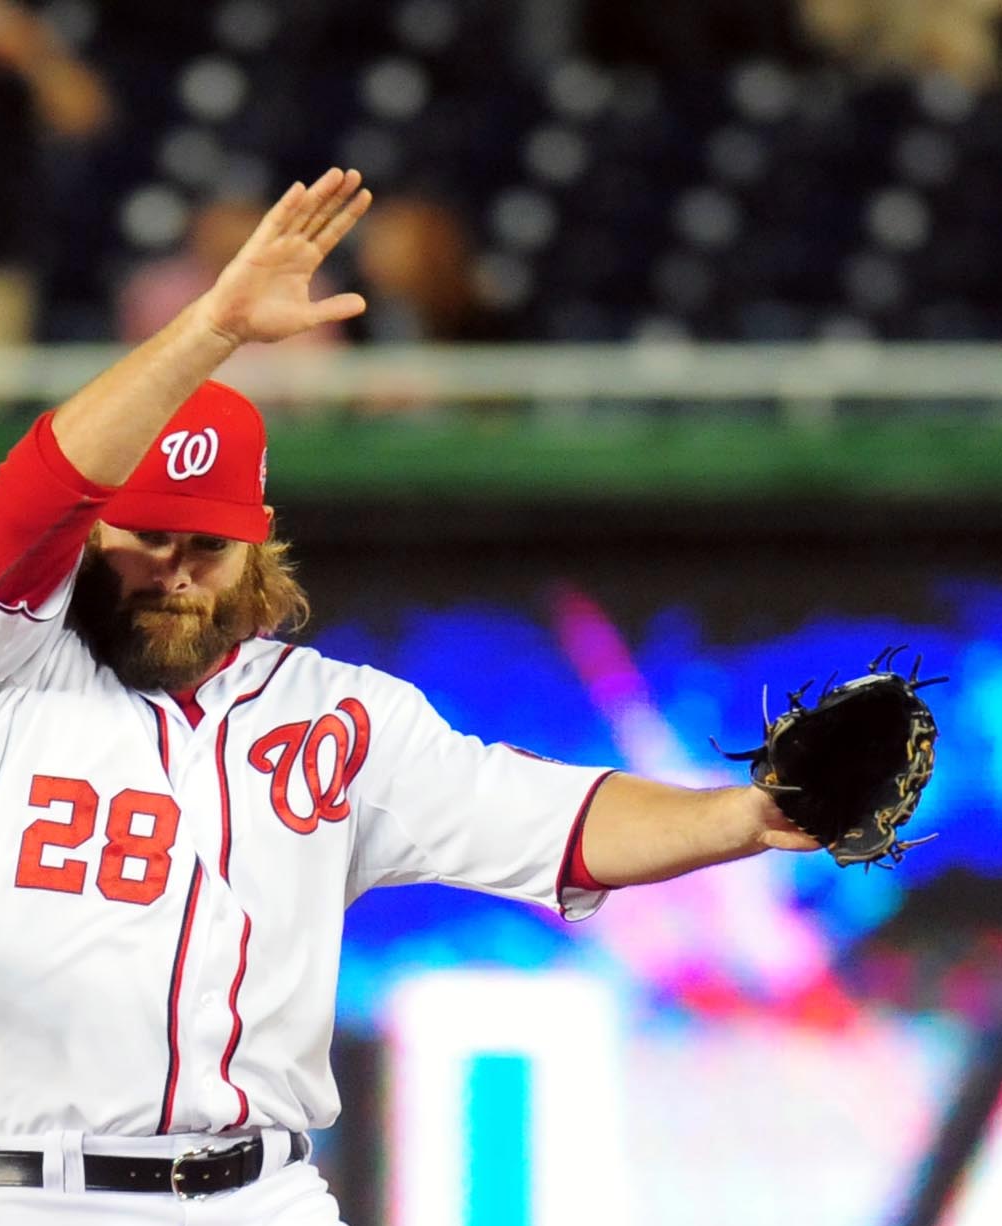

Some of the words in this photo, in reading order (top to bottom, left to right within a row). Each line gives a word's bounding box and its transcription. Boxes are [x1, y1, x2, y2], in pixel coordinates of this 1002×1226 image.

[160, 426, 219, 481] W
[247, 697, 369, 834] W
[14, 774, 181, 905] 28
